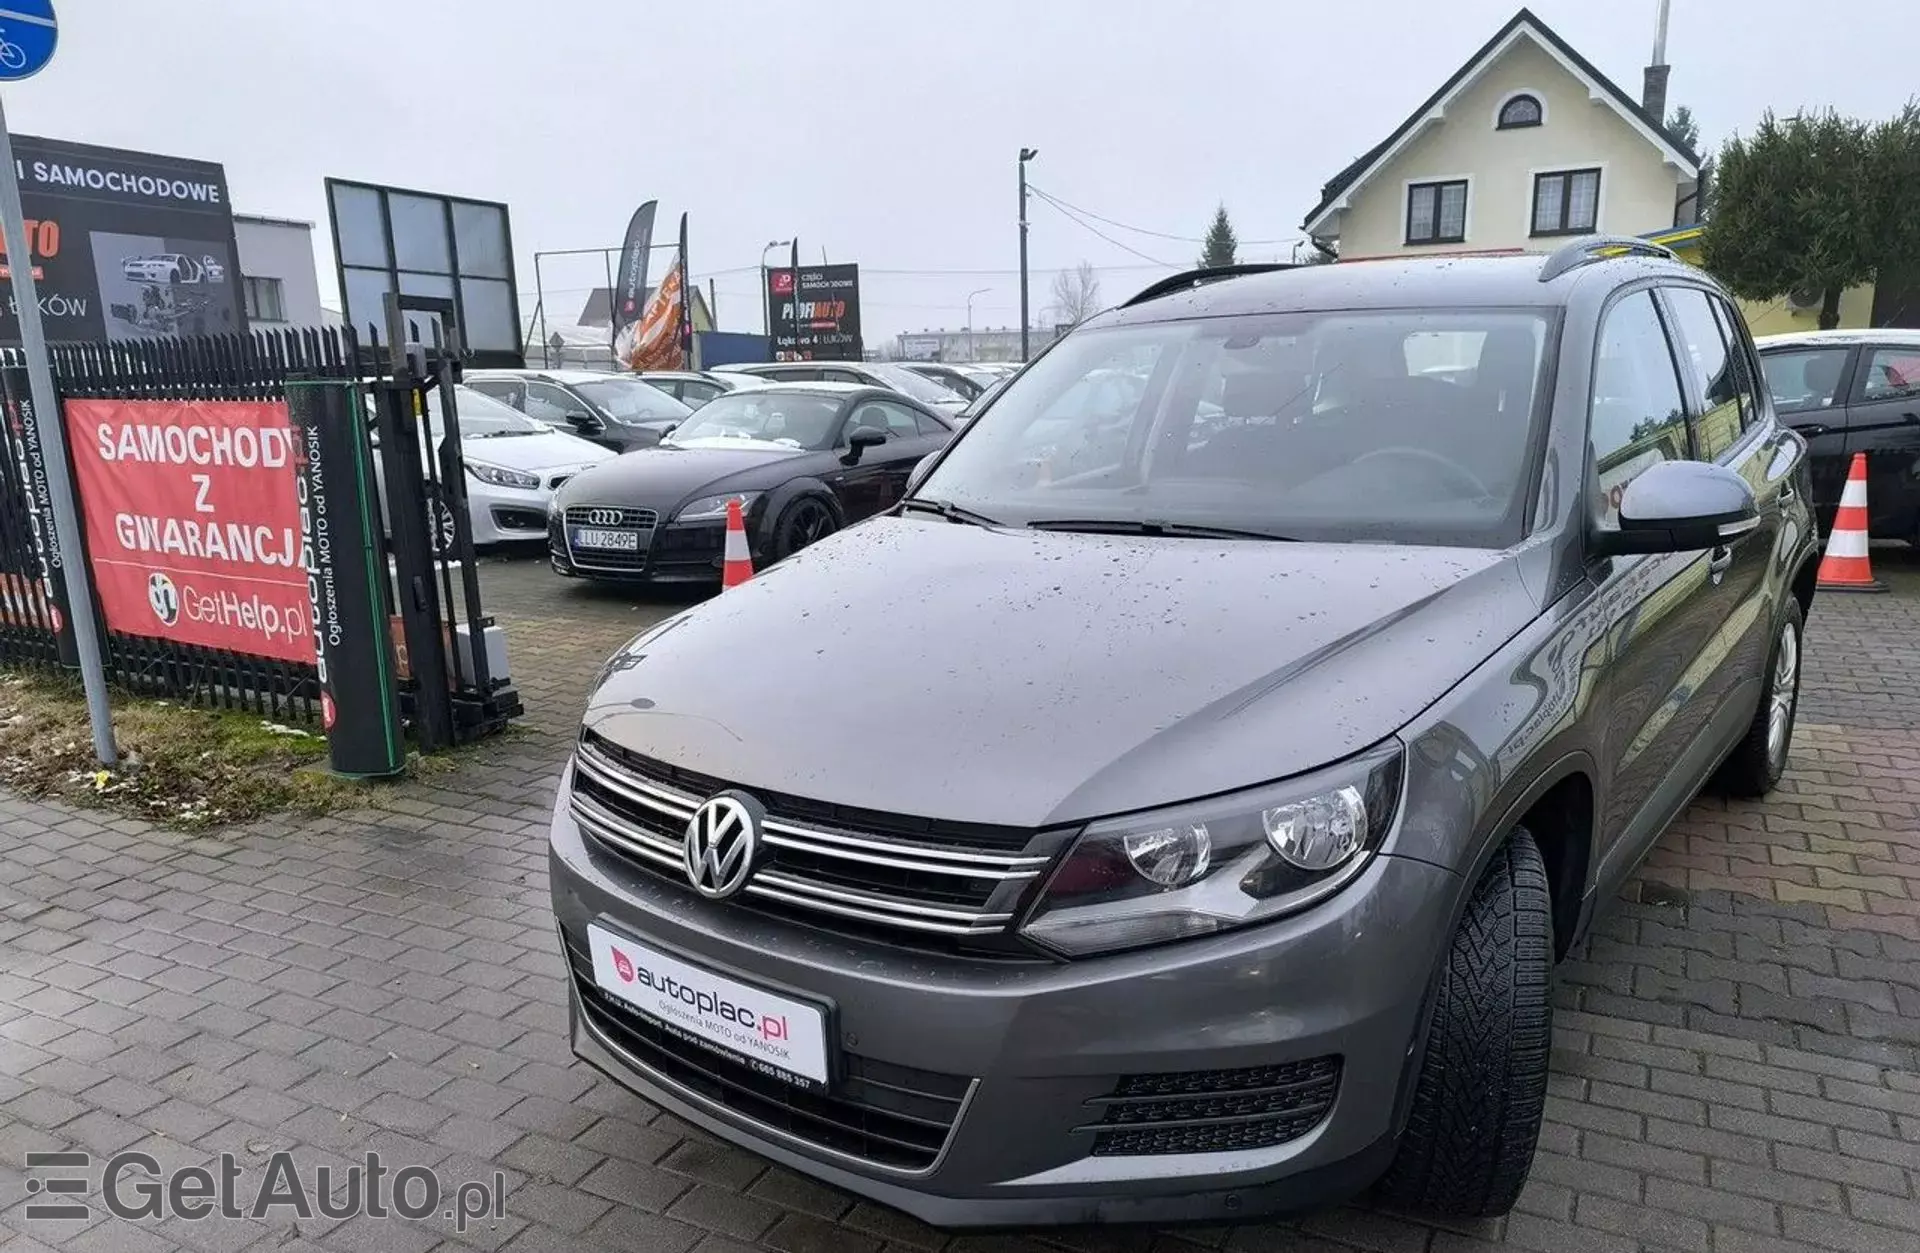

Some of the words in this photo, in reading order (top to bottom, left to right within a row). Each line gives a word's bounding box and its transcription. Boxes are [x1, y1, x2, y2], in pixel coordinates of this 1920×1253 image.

[34, 163, 220, 203] SAMOCHODOWE
[9, 293, 87, 317] ŁKÓW
[20, 399, 38, 451] YANOSIK
[307, 425, 324, 493] YANOSIK
[37, 468, 50, 506] MOTO
[192, 474, 214, 513] Z
[314, 495, 327, 515] od
[316, 517, 333, 564] MOTO
[183, 585, 308, 644] GetHelp.pl
[322, 567, 343, 647] Ogłoszenia
[637, 964, 788, 1041] autoplac.pl
[704, 1020, 732, 1038] MOTO
[748, 1038, 791, 1060] YANOSIK
